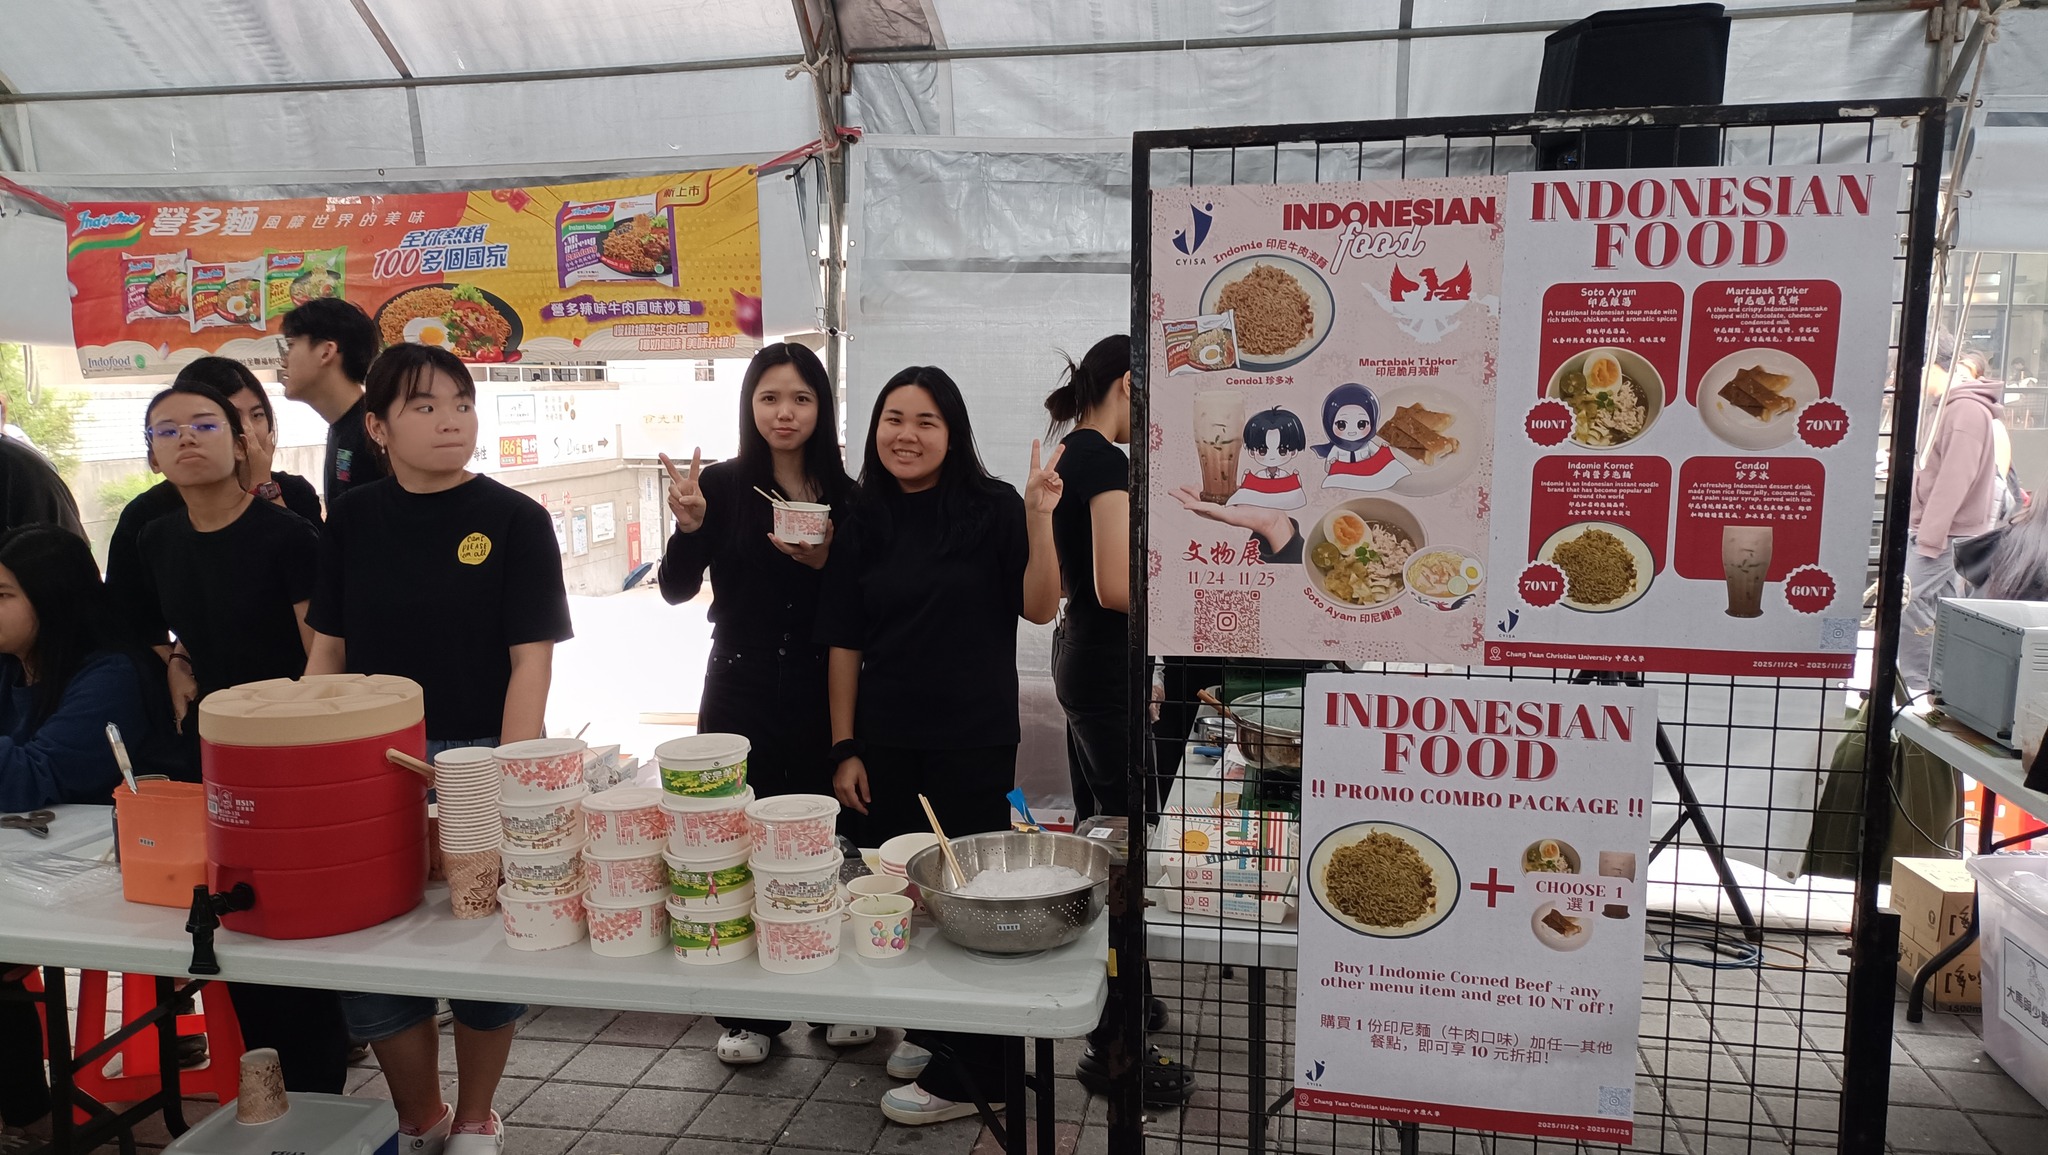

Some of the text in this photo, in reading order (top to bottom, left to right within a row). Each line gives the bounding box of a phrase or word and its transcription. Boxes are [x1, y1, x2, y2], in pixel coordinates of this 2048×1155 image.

[663, 185, 700, 198] 新上市
[1529, 174, 1876, 222] INDONESIAN
[149, 206, 425, 237] 營多麵 風靡世界的美味
[1282, 196, 1496, 231] INDONESIAN
[400, 223, 488, 249] 全球熱銷
[1329, 220, 1427, 275] food
[1591, 219, 1788, 271] FOOD
[373, 244, 509, 279] 100多個國家
[1175, 258, 1207, 266] CYISA
[1213, 238, 1329, 270] Indomie 印尼牛肉泡麵
[1580, 287, 1637, 298] Soto Ayam
[1725, 286, 1809, 296] Martabak Tipker
[551, 300, 692, 318] 營多辣味牛肉風味炒麵
[87, 354, 131, 371] Indofood
[1358, 356, 1458, 369] Martabak Tipker
[1375, 366, 1440, 378] 印尼脆月亮餅
[1225, 375, 1295, 386] Cendol 珍多冰
[1530, 419, 1568, 430] 100NT
[1805, 419, 1843, 431] 70NT
[1567, 461, 1634, 470] Indomie Kornet
[1734, 461, 1769, 470] Cendol
[1735, 470, 1770, 481] 珍多冰
[1721, 495, 1740, 503] sugar
[1753, 489, 1770, 497] jelly,
[1182, 539, 1266, 567] 文物展
[1187, 569, 1275, 588] 11/24 11/25
[1523, 580, 1559, 592] 70NT
[1790, 584, 1831, 598] 60NT
[1303, 586, 1403, 624] Soto Ayam 印尼雞湯
[1505, 650, 1527, 659] Chung
[1528, 651, 1545, 659] Yuan
[1546, 652, 1577, 660] Christian
[1578, 653, 1613, 663] University
[1752, 660, 1853, 670] 2025/11/24 2025/11/25
[1323, 691, 1637, 743] INDONESIAN
[1381, 731, 1559, 782] FOOD
[1311, 778, 1645, 818] !! PROMO COMBO PACKAGE !!
[1535, 879, 1624, 899] CHOOSE 1
[1565, 897, 1595, 912] 選 1
[1333, 960, 1364, 977] Buy
[1368, 963, 1375, 976] 1
[1379, 965, 1446, 982] Indomie
[1450, 970, 1510, 988] Corned
[1515, 976, 1553, 993] Beef
[1570, 986, 1602, 1000] any
[1320, 976, 1606, 1015] other menu item and get 10 NT off
[1320, 1013, 1351, 1031] 購買
[1355, 1019, 1363, 1031] 1
[1471, 1045, 1489, 1058] 10
[1313, 1098, 1333, 1107] Chung
[1350, 1102, 1379, 1111] Christian
[1379, 1105, 1411, 1115] University
[1537, 1121, 1630, 1136] 2025/11/24 2025/11/25
